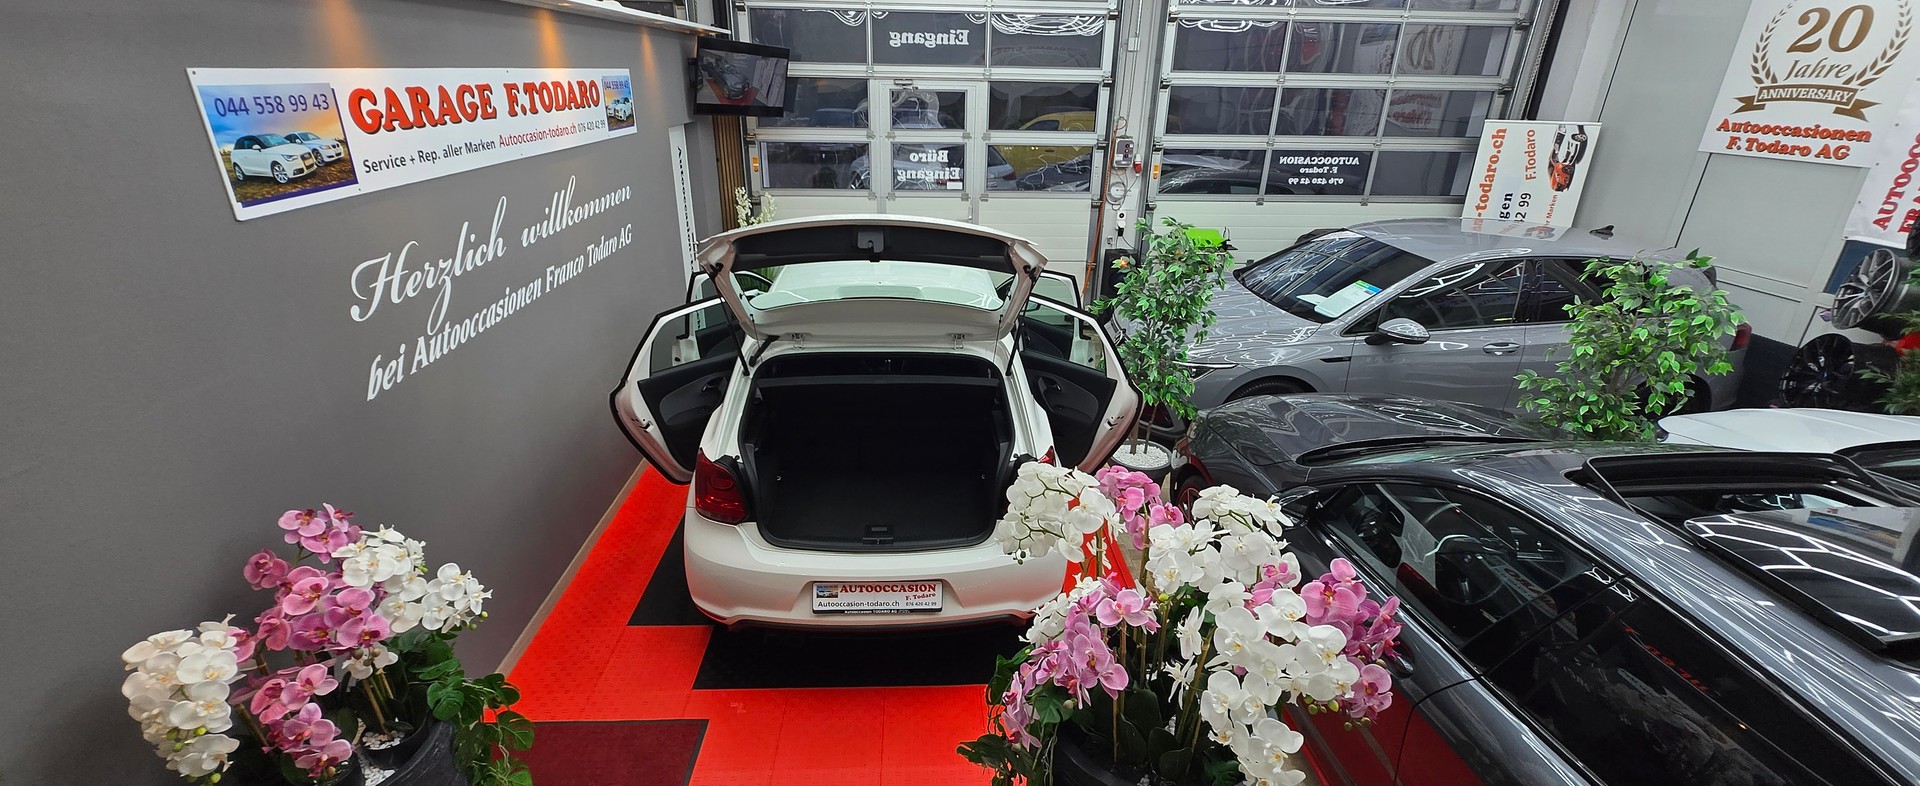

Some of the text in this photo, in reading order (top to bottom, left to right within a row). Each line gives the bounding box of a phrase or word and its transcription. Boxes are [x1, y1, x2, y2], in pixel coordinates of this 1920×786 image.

[1787, 4, 1875, 53] 20
[1783, 57, 1853, 81] Jahre
[214, 93, 330, 117] 044 558 99 43
[348, 80, 600, 135] GARAGE F.TODARO
[1758, 88, 1854, 103] ANNIVERSARY
[1716, 118, 1873, 143] Autooccasionen
[363, 154, 407, 174] Service
[417, 149, 441, 164] Rep.
[443, 144, 463, 159] aller
[464, 139, 497, 154] Marken
[499, 122, 577, 148] Autooccasion-todaro.ch
[577, 122, 587, 134] 076
[587, 121, 595, 131] 420
[1524, 129, 1537, 181] F.Todaro
[1726, 136, 1850, 160] F. Todaro AG
[1872, 132, 1920, 231] AUTOOC
[1518, 193, 1532, 207] 99
[350, 196, 507, 335] Herzlich
[520, 175, 632, 248] willkommen
[367, 223, 632, 401] bei Autooccasionen Franco Todaro AG
[840, 584, 937, 593] AUTOOCCASION
[913, 592, 936, 600] Todaro
